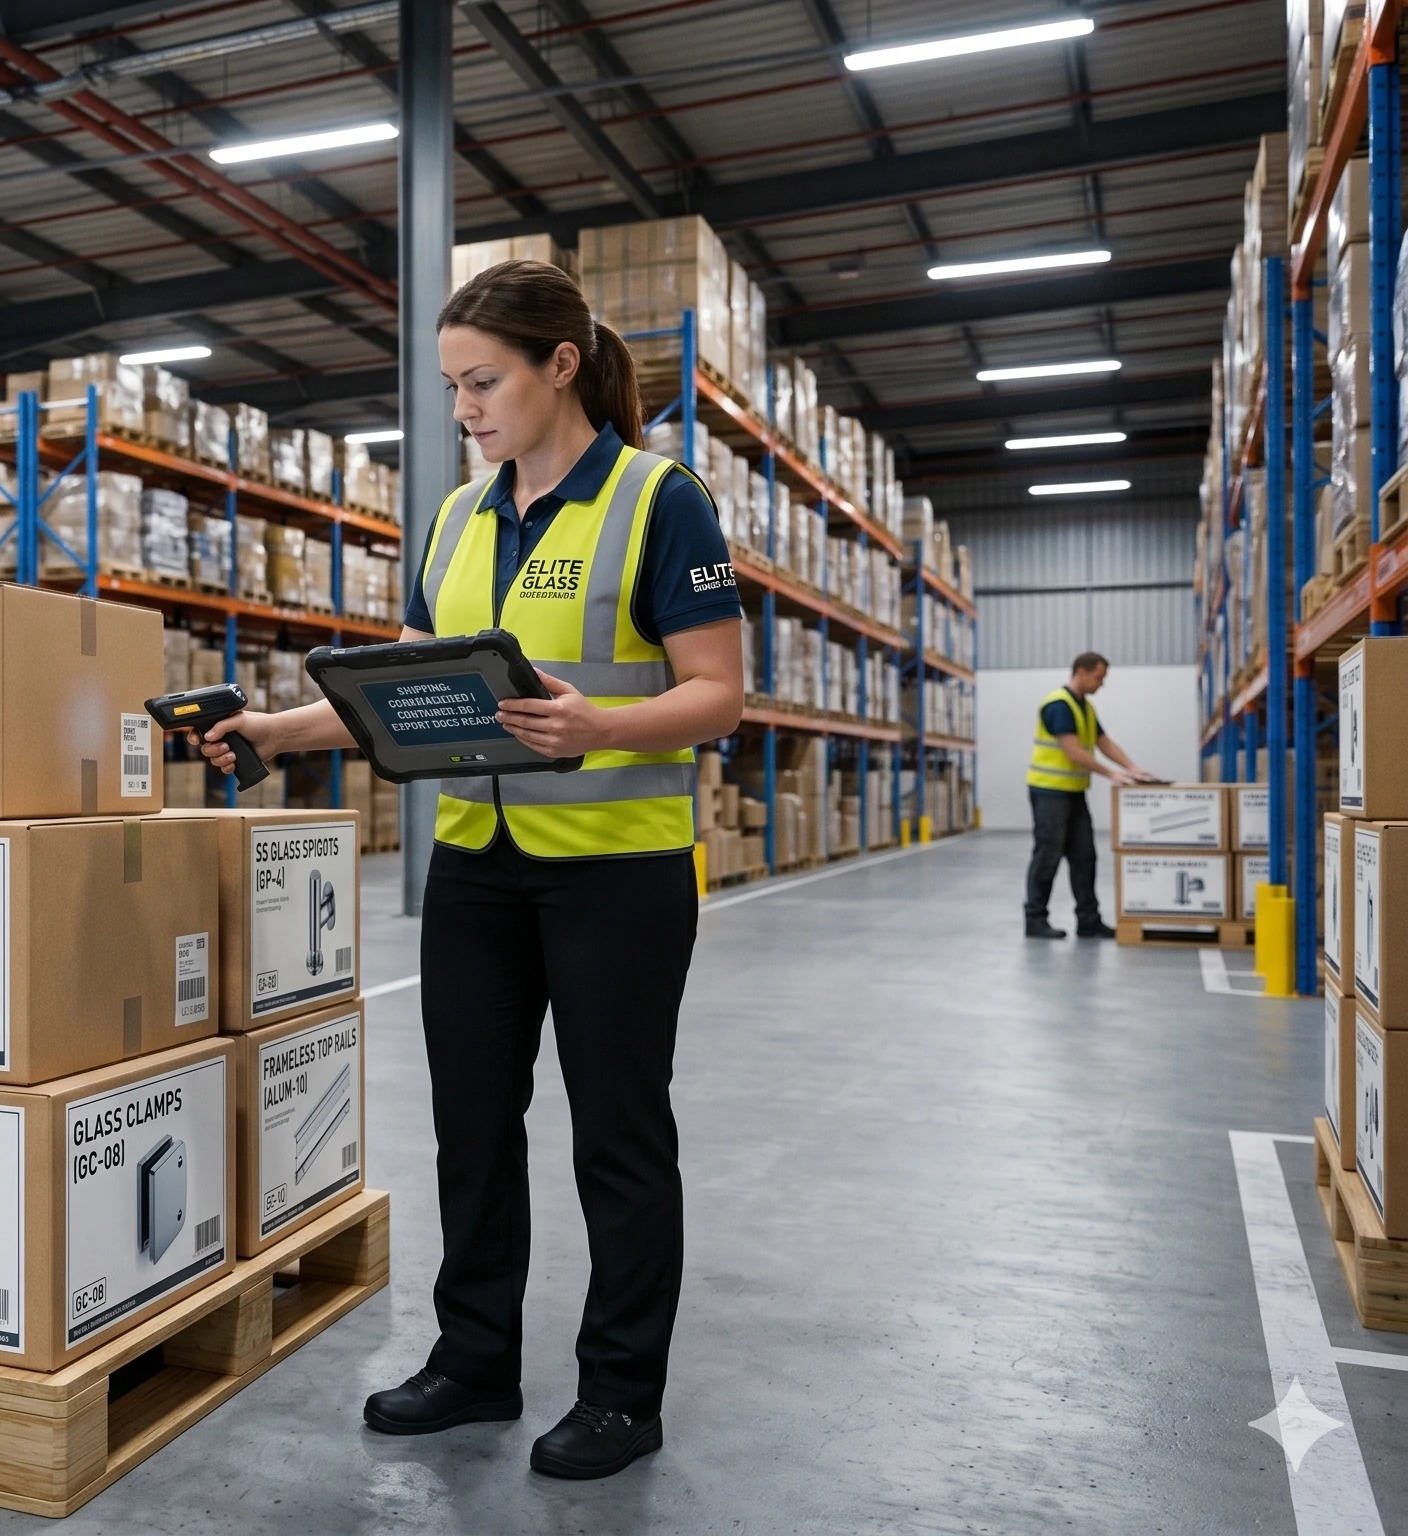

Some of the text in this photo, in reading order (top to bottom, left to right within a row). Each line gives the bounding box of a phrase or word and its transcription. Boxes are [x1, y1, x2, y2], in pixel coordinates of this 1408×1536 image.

[522, 576, 579, 589] GLASS
[526, 560, 583, 574] ELITE
[255, 837, 339, 863] SS GLASS SPIGOTS
[263, 1027, 357, 1080] FRAMELESS TOP RAILS
[263, 1071, 307, 1110] (ALUM-10)
[73, 1088, 182, 1145] GLASS CLAMPS
[73, 1138, 125, 1184] (GC-08)
